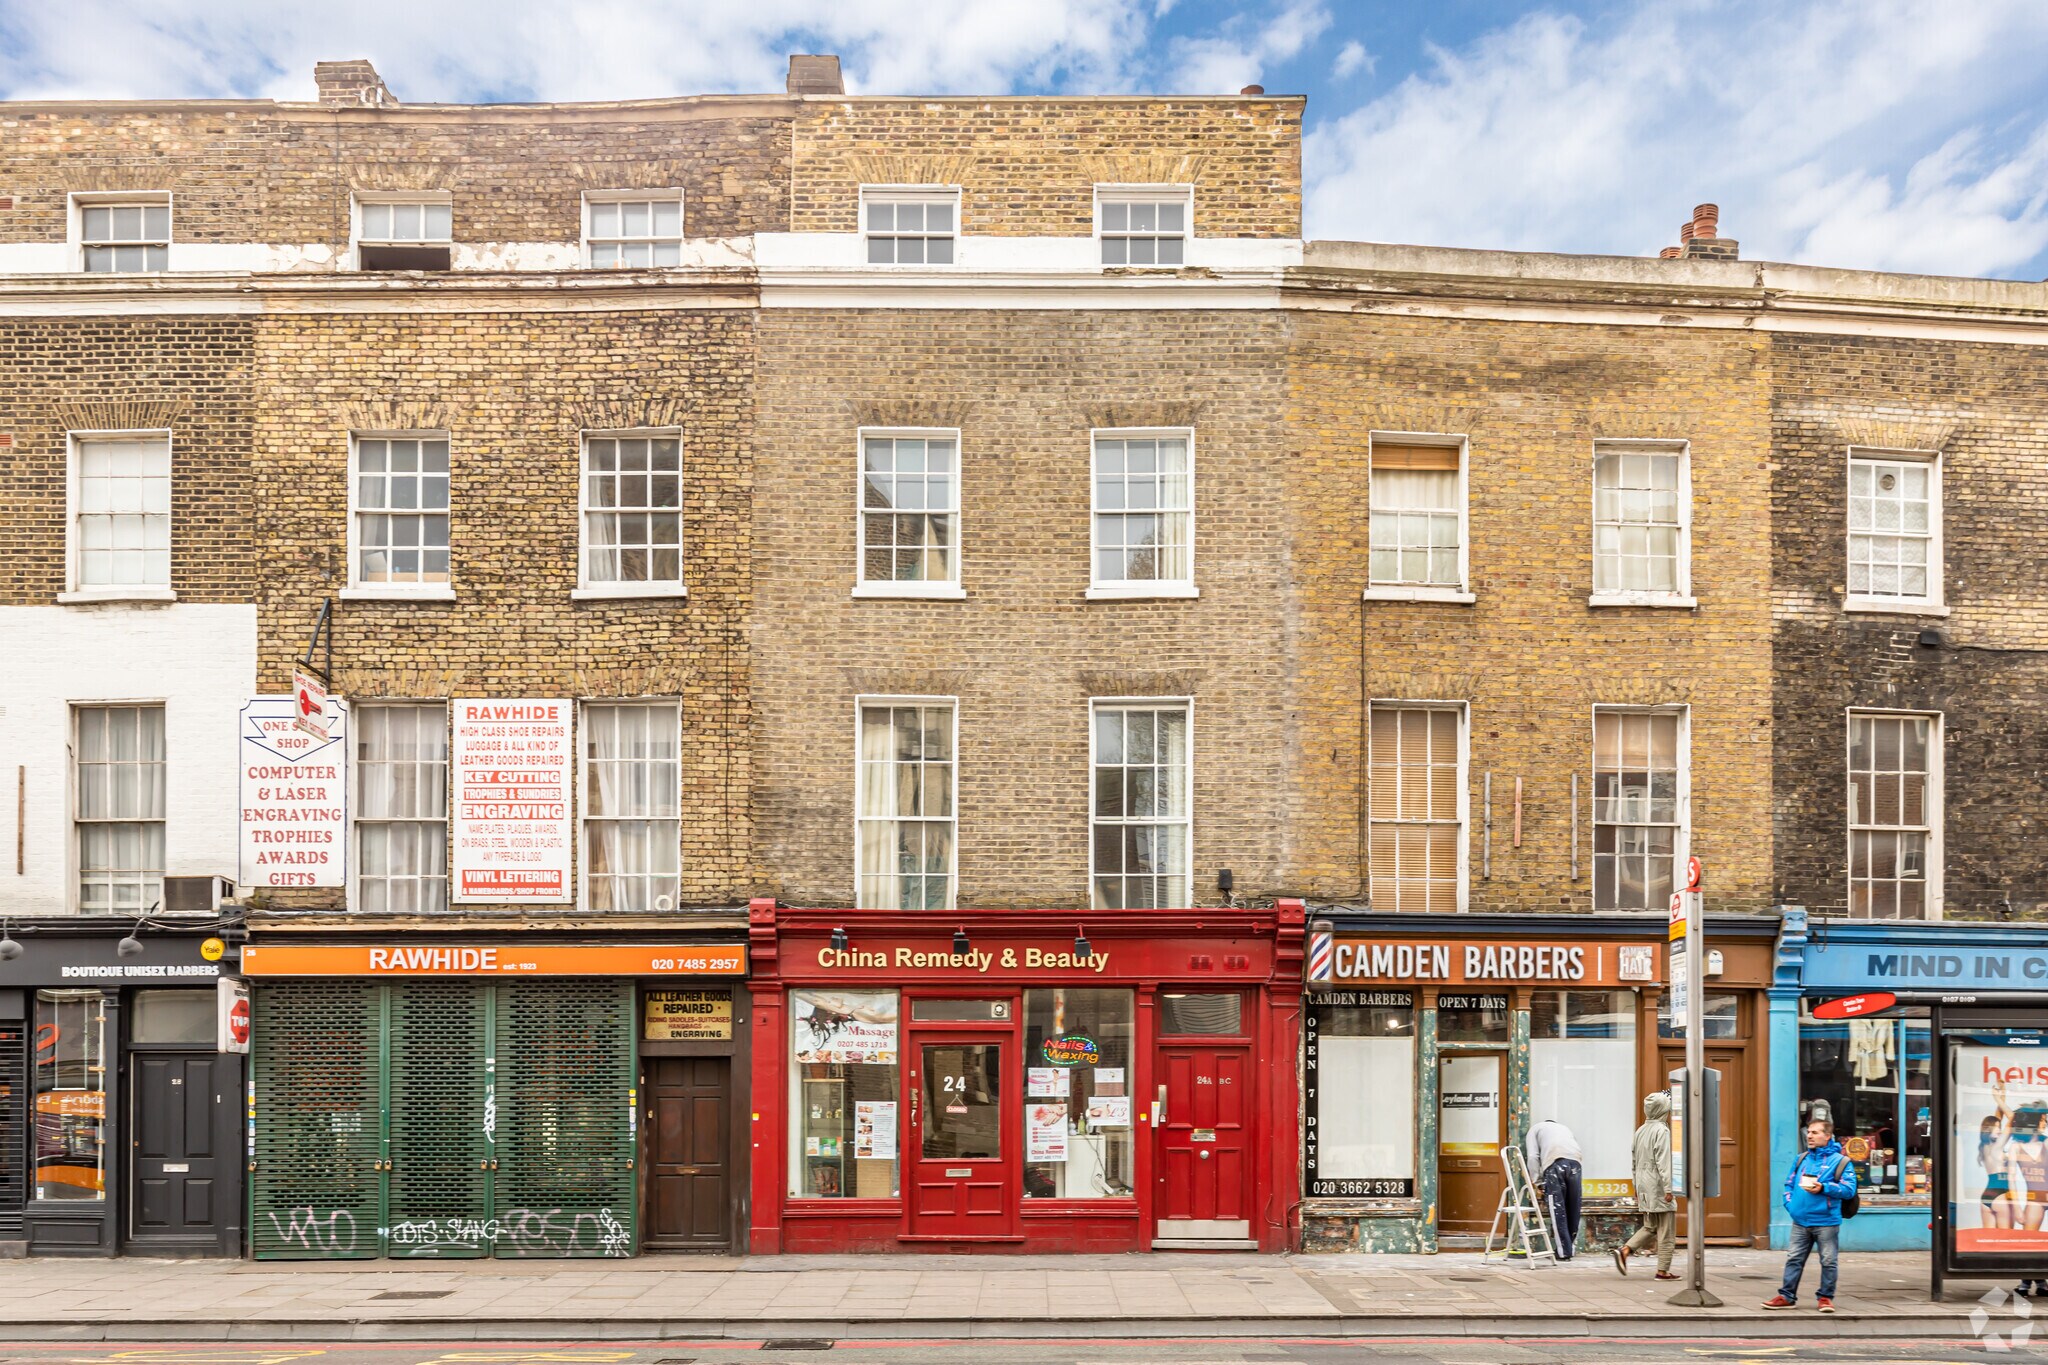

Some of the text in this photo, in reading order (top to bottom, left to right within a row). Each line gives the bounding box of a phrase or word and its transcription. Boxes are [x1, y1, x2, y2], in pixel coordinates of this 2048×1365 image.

[466, 706, 558, 720] RAWHIDE
[263, 721, 288, 731] ONE
[460, 727, 565, 737] HIGH CLASS SHOE REPAIRS
[277, 738, 310, 749] SHOP
[466, 741, 559, 751] LUGGAGE & ALL KIND OF
[460, 755, 564, 765] LEATHER GOODS REPAIRED
[248, 766, 336, 779] COMPUTER
[464, 771, 560, 783] KEY CUTTING
[258, 788, 327, 800] & LASER
[464, 788, 561, 799] TROPHIES & SUNDRIES
[243, 809, 342, 821] ENGRAVING
[462, 805, 563, 819] ENGRAVING
[468, 824, 483, 834] NAME
[252, 830, 333, 843] TROPHIES
[511, 838, 533, 848] WOODEN
[256, 851, 329, 864] AWARDS
[483, 852, 493, 861] ANY
[465, 871, 560, 883] VINYL LETTERING
[1688, 861, 1695, 882] S
[269, 873, 316, 885] GIFTS
[536, 887, 561, 895] FRONTS
[204, 946, 220, 954] Yale
[246, 949, 257, 957] 26
[369, 948, 498, 970] RAWHIDE
[651, 958, 674, 970] 020
[677, 958, 707, 970] 7485
[709, 958, 739, 970] 2957
[817, 947, 1109, 973] China Remedy & Beauty
[1335, 944, 1585, 980] CAMDEN BARBERS
[61, 965, 220, 977] BOUTIQUE UNISEX BARBERS
[1619, 957, 1653, 974] HAIR
[1867, 954, 2048, 979] MIND IN C
[647, 992, 732, 1002] ALL LEATHER GOODS
[1308, 992, 1412, 1006] CAMDEN BARBERS
[1439, 996, 1507, 1009] OPEN 7 DAYS
[663, 1003, 713, 1014] REPAIRED
[671, 1030, 722, 1038] ENGRAVING
[848, 1026, 895, 1039] Massage
[1048, 1048, 1099, 1064] Waxing
[943, 1075, 966, 1092] 24
[1307, 1017, 1316, 1169] OPEN 7 DAYS
[1313, 1181, 1405, 1194] 020 3662 5328
[1597, 1183, 1629, 1194] 5328
